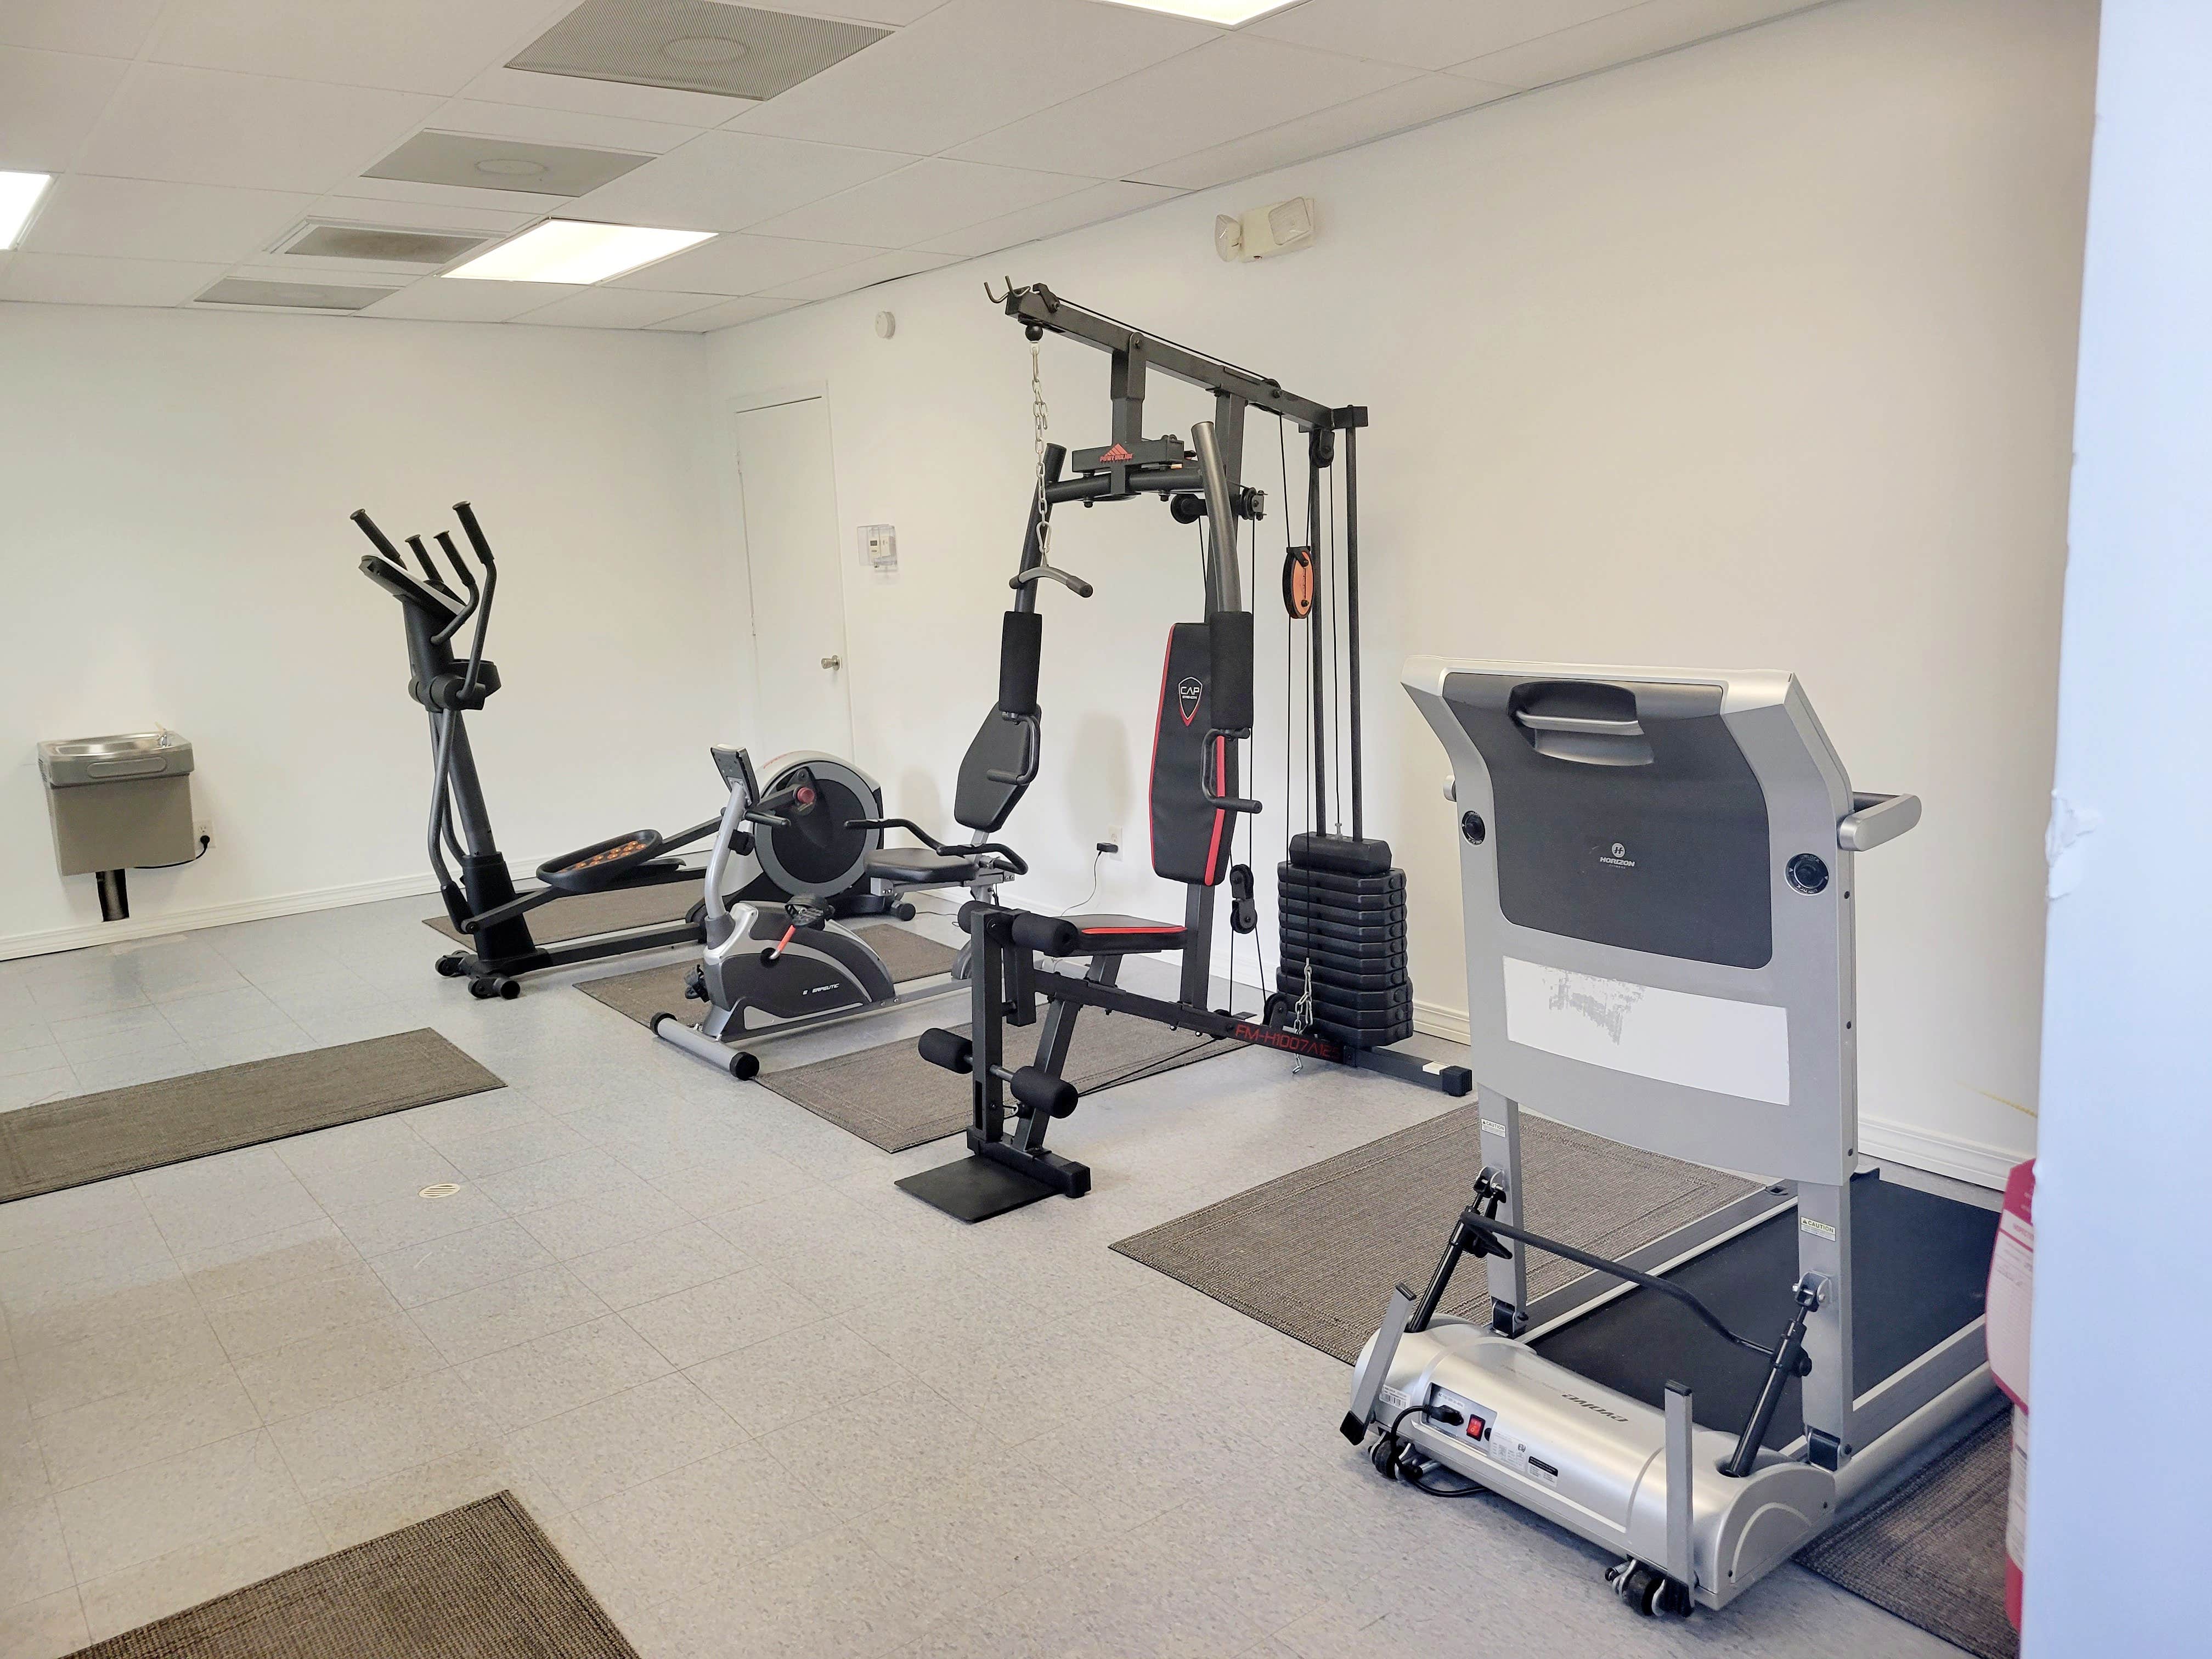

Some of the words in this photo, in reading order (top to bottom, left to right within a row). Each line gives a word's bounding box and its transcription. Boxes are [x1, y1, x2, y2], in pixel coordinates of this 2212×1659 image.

[1180, 686, 1200, 695] CAP
[1599, 856, 1635, 867] HORIZON
[1486, 1121, 1504, 1130] CAUTION
[1808, 1220, 1833, 1233] CAUTION
[1562, 1393, 1629, 1422] evolve
